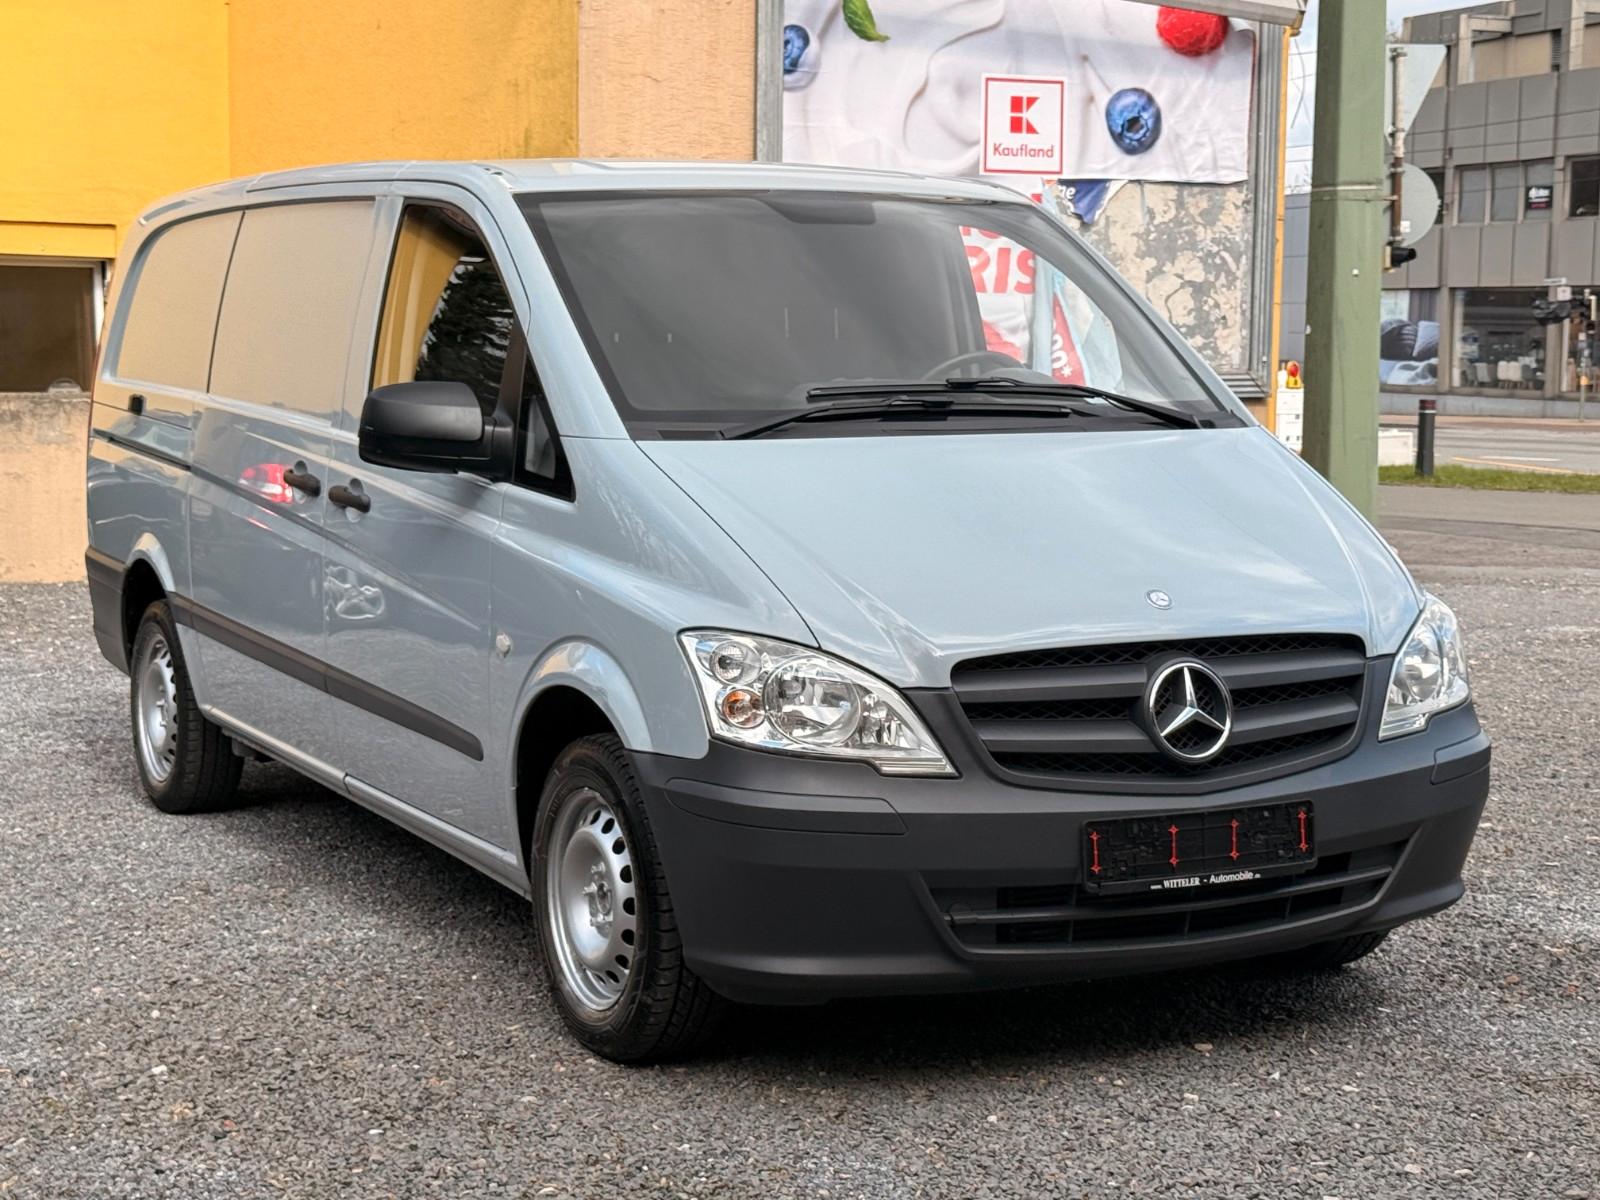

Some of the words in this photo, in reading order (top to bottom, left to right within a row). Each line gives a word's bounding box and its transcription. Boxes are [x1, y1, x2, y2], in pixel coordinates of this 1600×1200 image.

[1010, 96, 1040, 134] K
[993, 143, 1054, 158] Kaufland
[1163, 877, 1200, 888] WITTELER
[1209, 870, 1254, 884] Automobile
